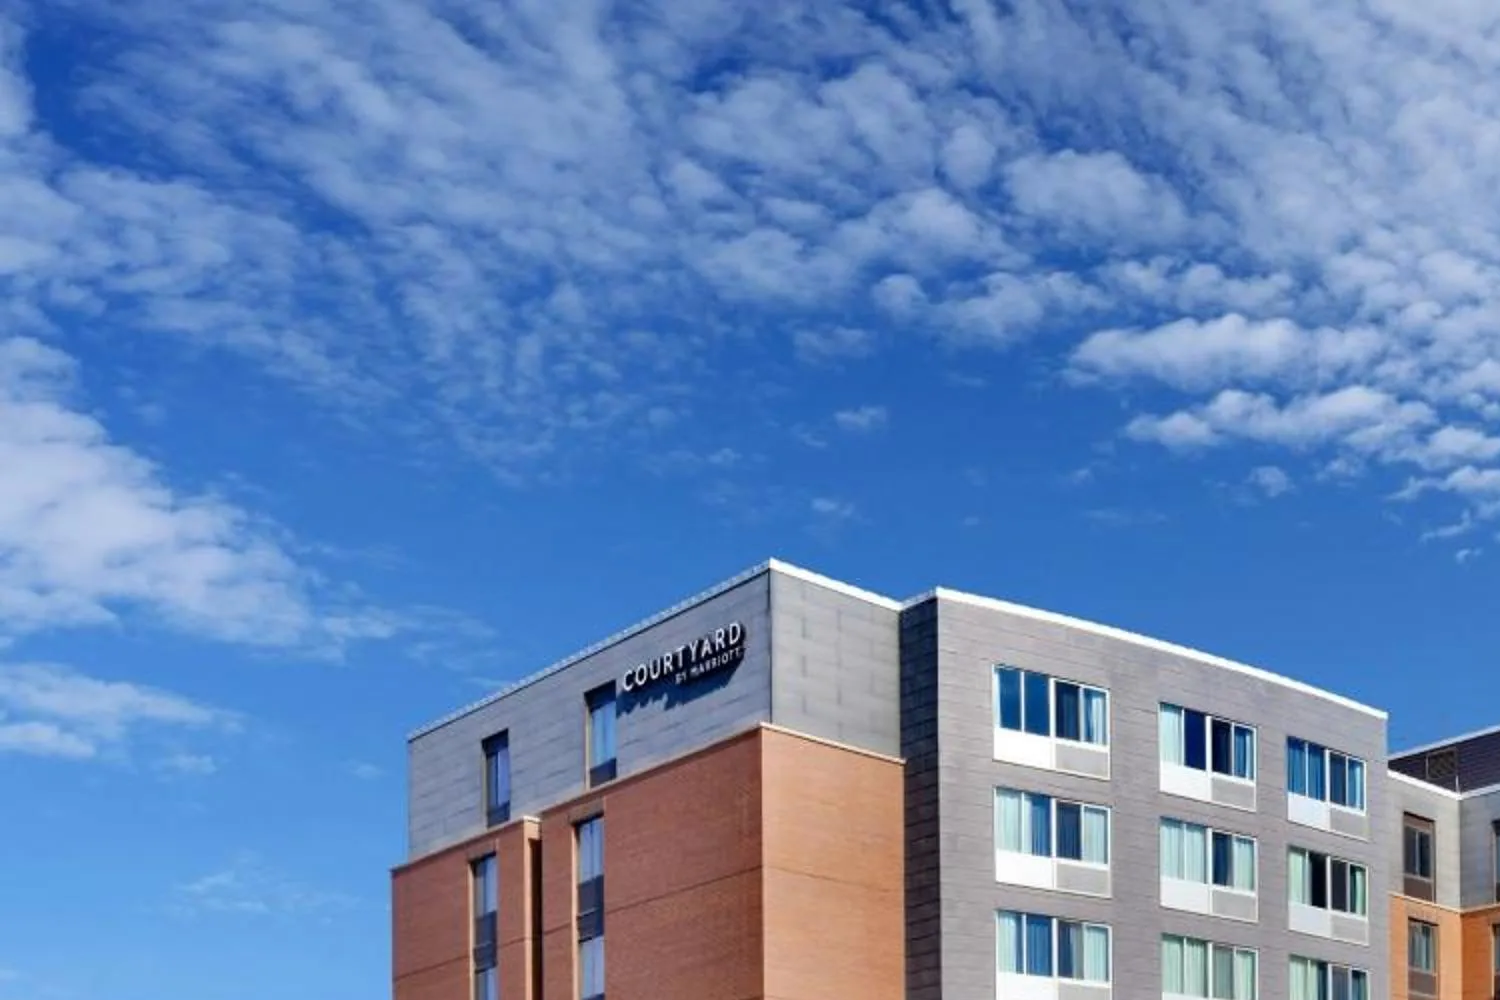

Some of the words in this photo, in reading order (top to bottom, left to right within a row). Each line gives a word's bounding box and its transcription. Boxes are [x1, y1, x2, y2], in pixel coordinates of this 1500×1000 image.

[622, 621, 742, 692] COURTYARD
[674, 671, 688, 685] BY
[690, 646, 742, 677] MARRIOTT
